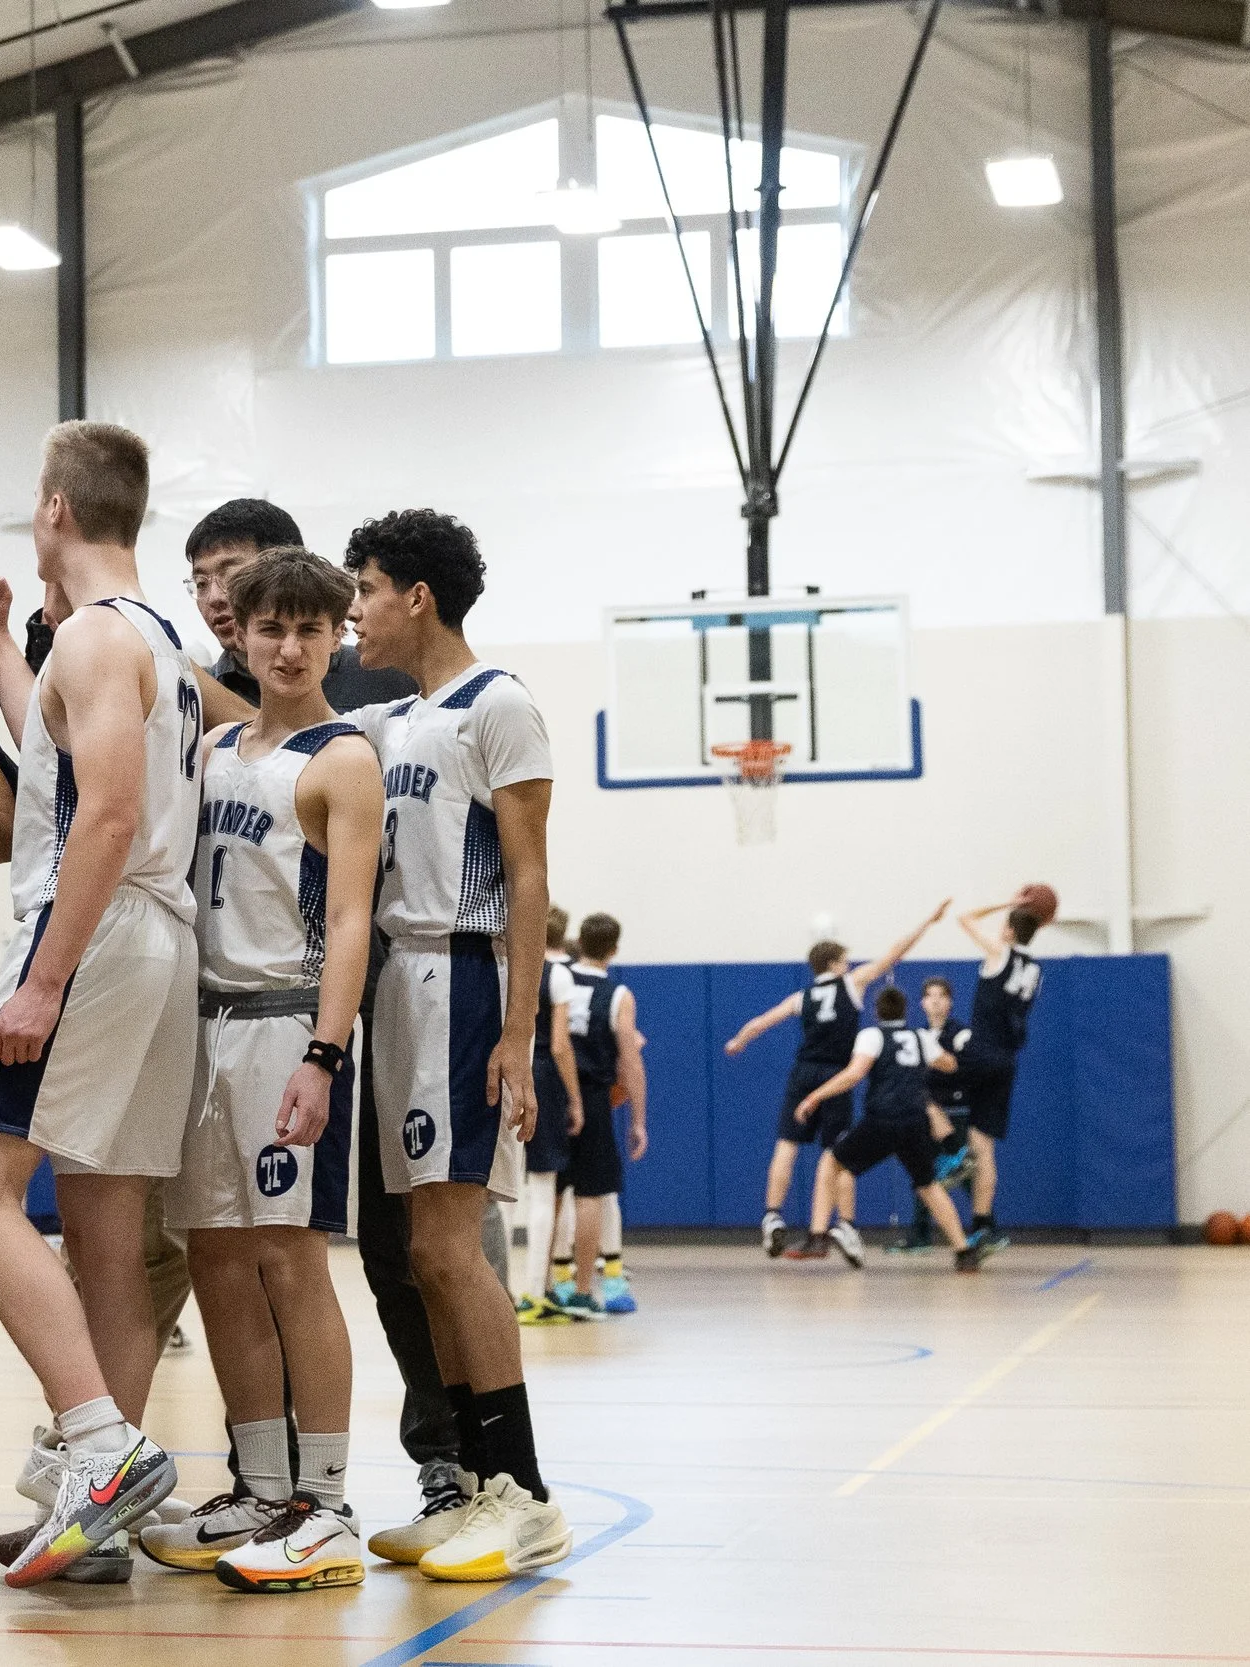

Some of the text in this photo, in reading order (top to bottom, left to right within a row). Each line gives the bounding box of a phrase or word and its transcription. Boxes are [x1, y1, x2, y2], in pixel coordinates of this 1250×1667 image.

[382, 763, 439, 804] UNDER
[198, 800, 274, 846] HUNDER
[810, 984, 838, 1022] 7
[892, 1030, 921, 1067] 3
